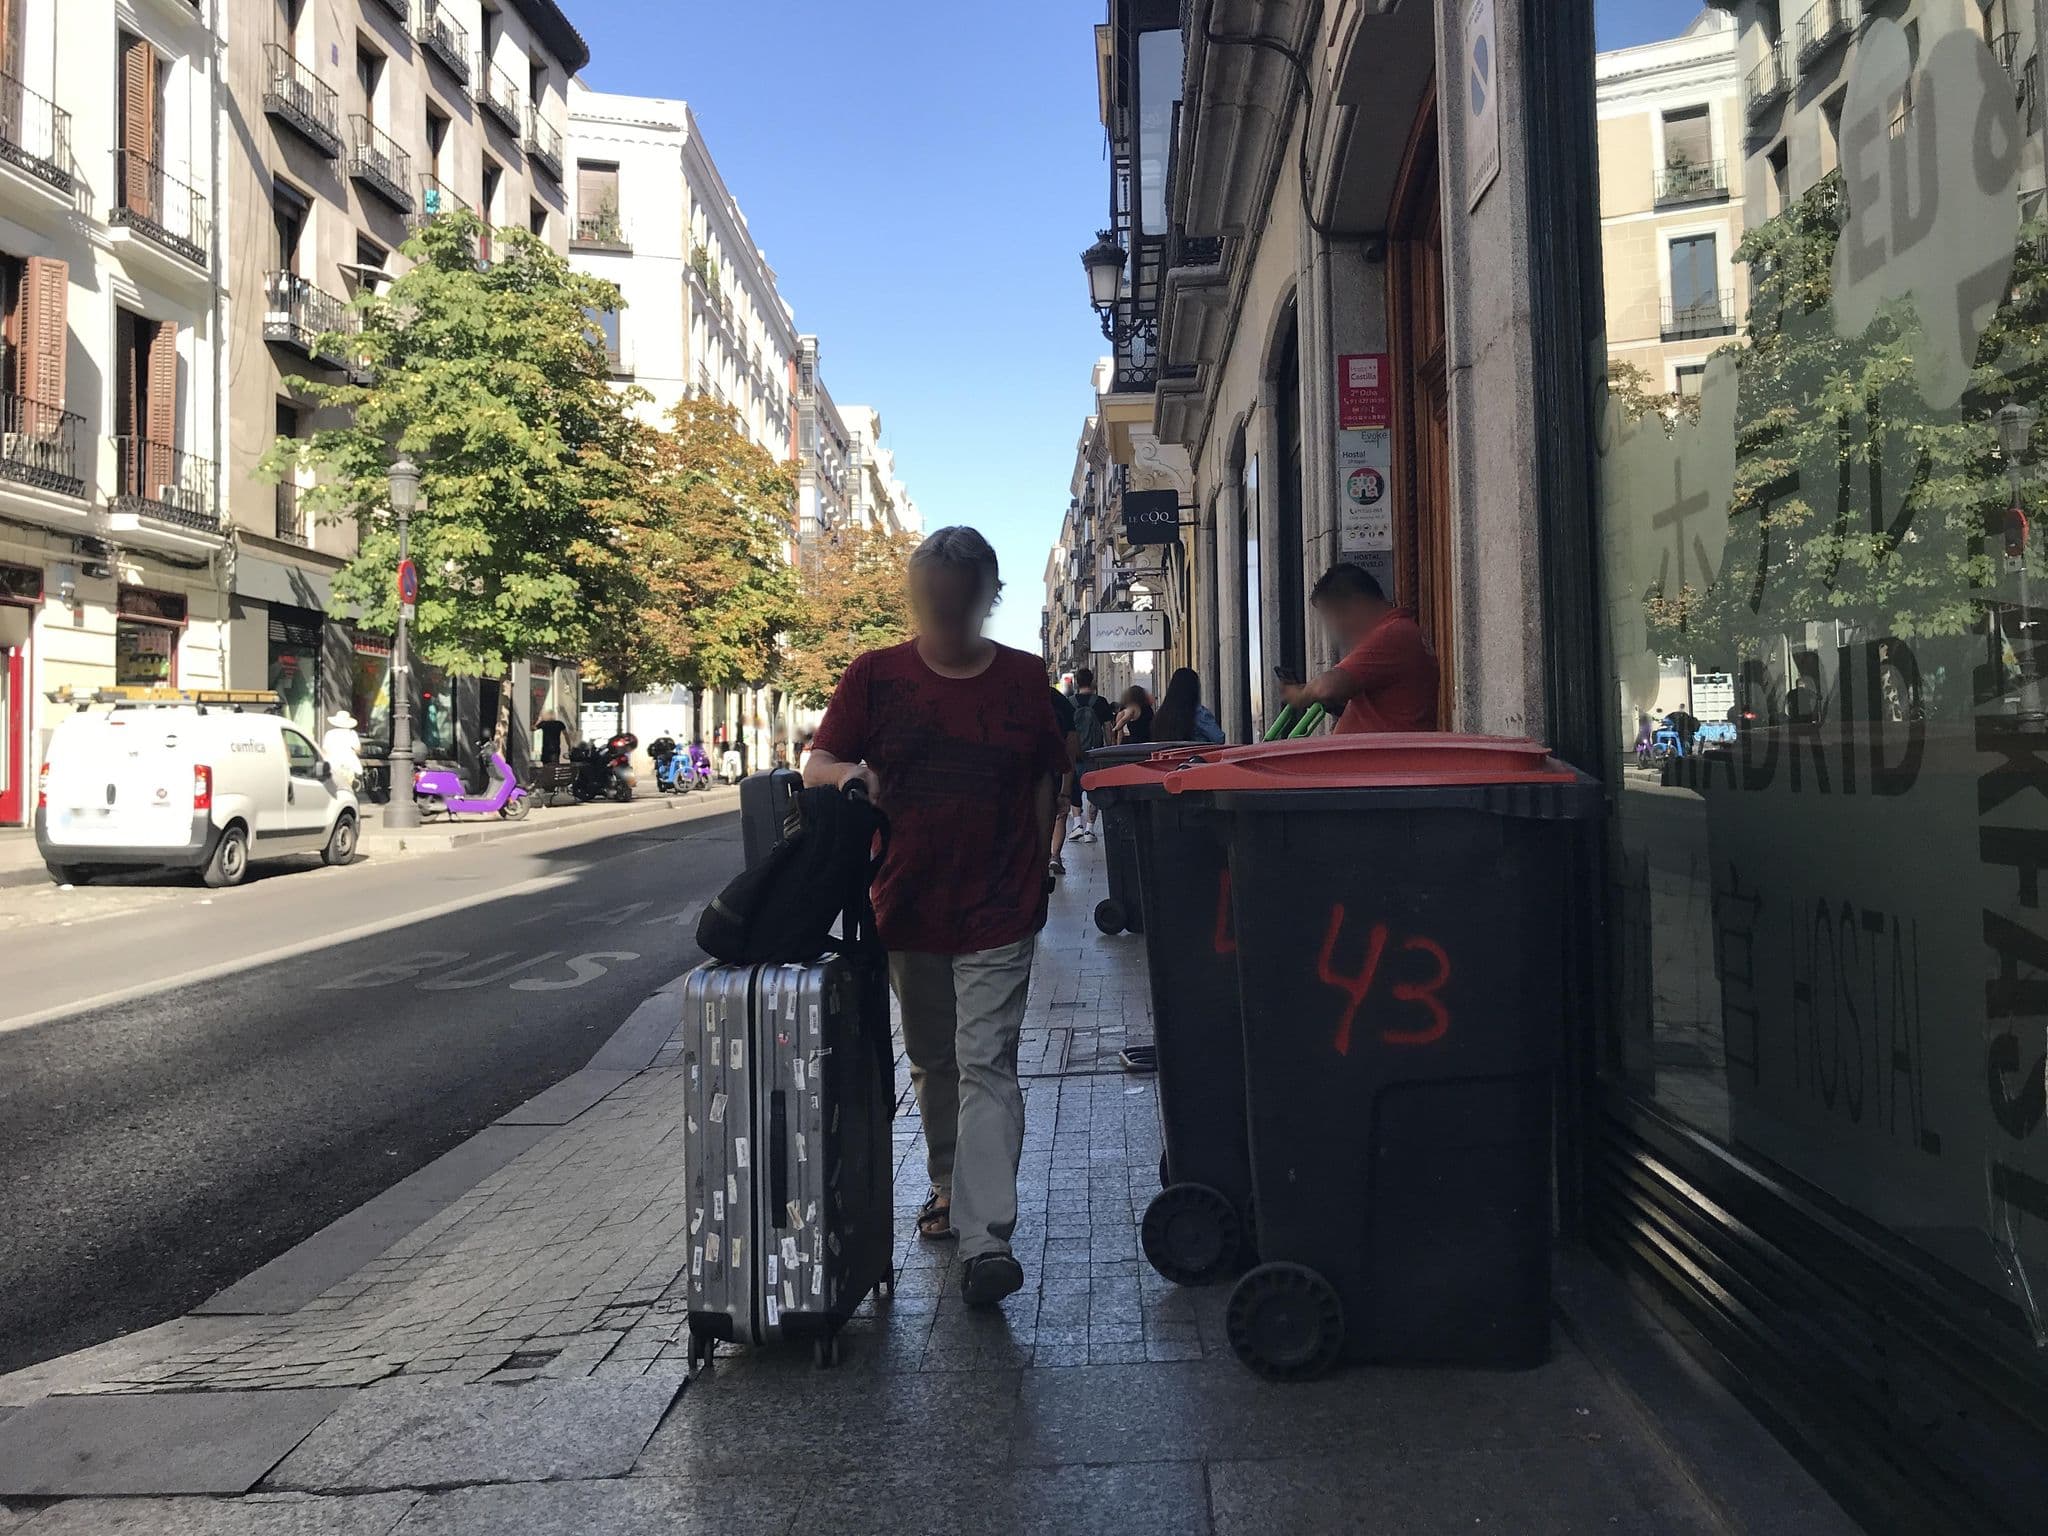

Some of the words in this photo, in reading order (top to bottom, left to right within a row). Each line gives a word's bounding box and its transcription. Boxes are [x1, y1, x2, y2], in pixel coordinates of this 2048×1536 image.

[1342, 450, 1366, 459] Hostal
[1140, 511, 1176, 525] COQ
[1354, 553, 1381, 561] HOSTAL
[316, 950, 642, 992] BUS
[1317, 902, 1453, 1057] 43
